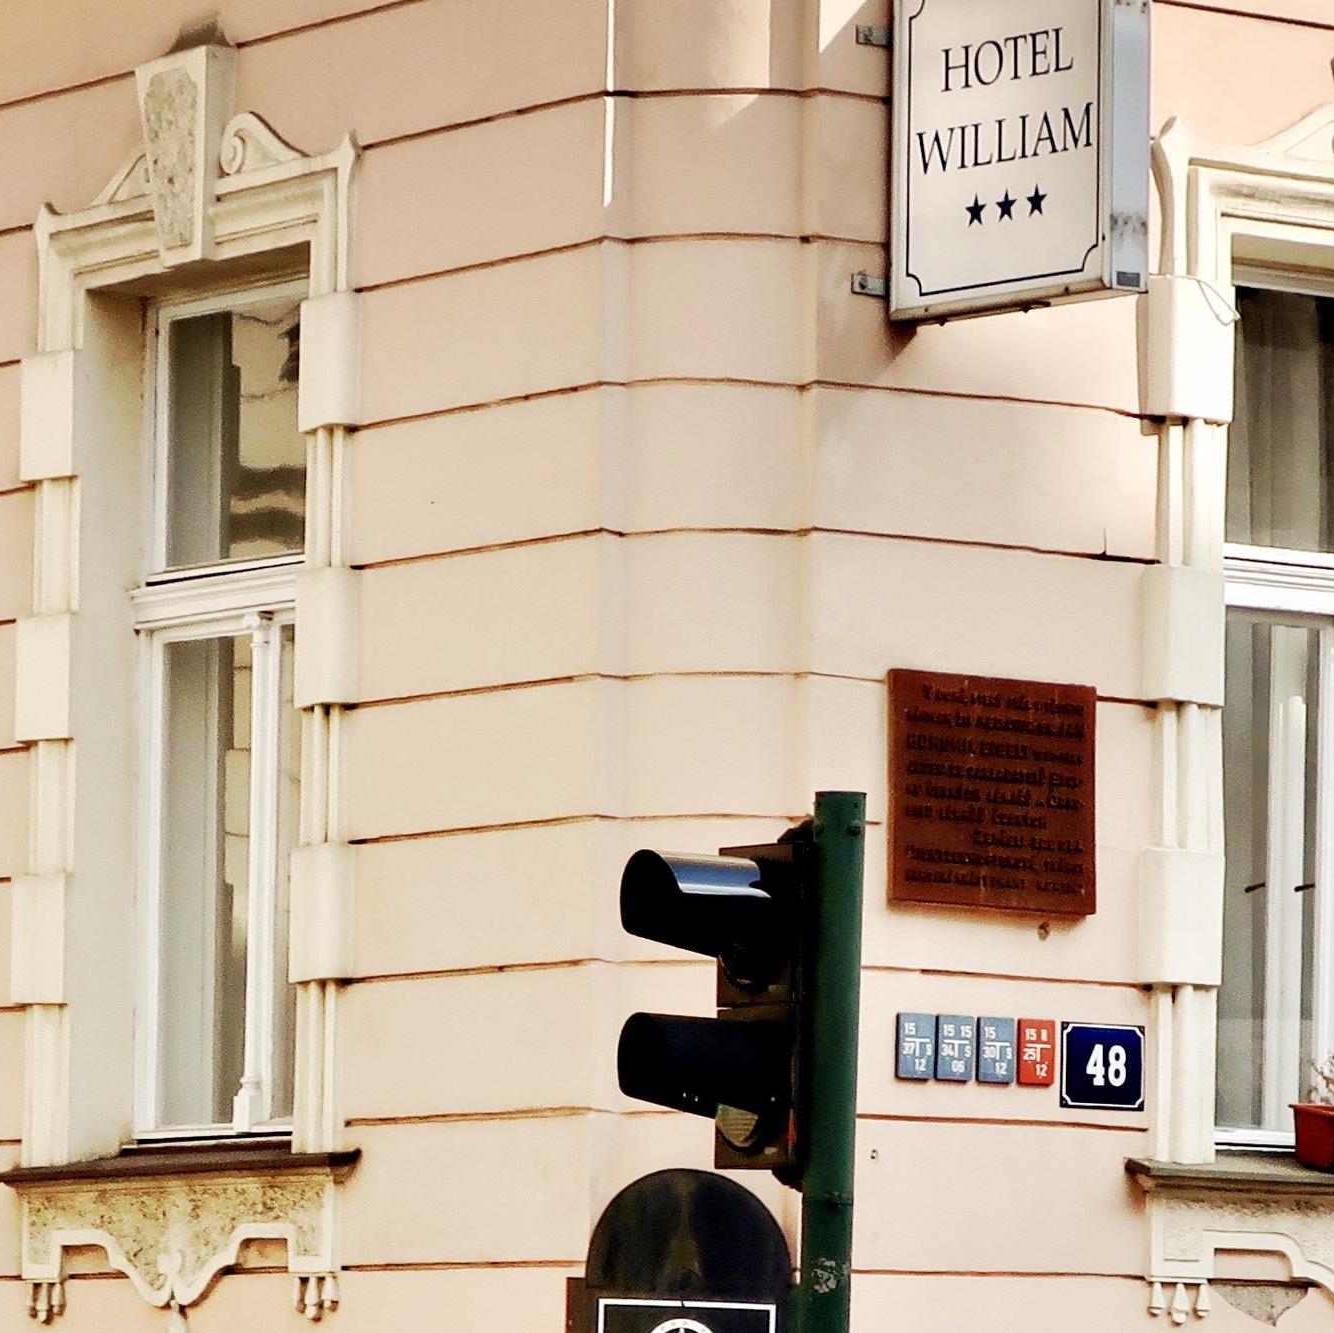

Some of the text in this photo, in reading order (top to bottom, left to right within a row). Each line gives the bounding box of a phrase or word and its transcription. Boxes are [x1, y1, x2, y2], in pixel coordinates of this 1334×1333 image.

[940, 27, 1074, 92] HOTEL
[916, 102, 1093, 174] WILLIAM
[915, 1059, 926, 1071] 12
[995, 1061, 1007, 1075] 12
[1086, 1044, 1127, 1087] 48
